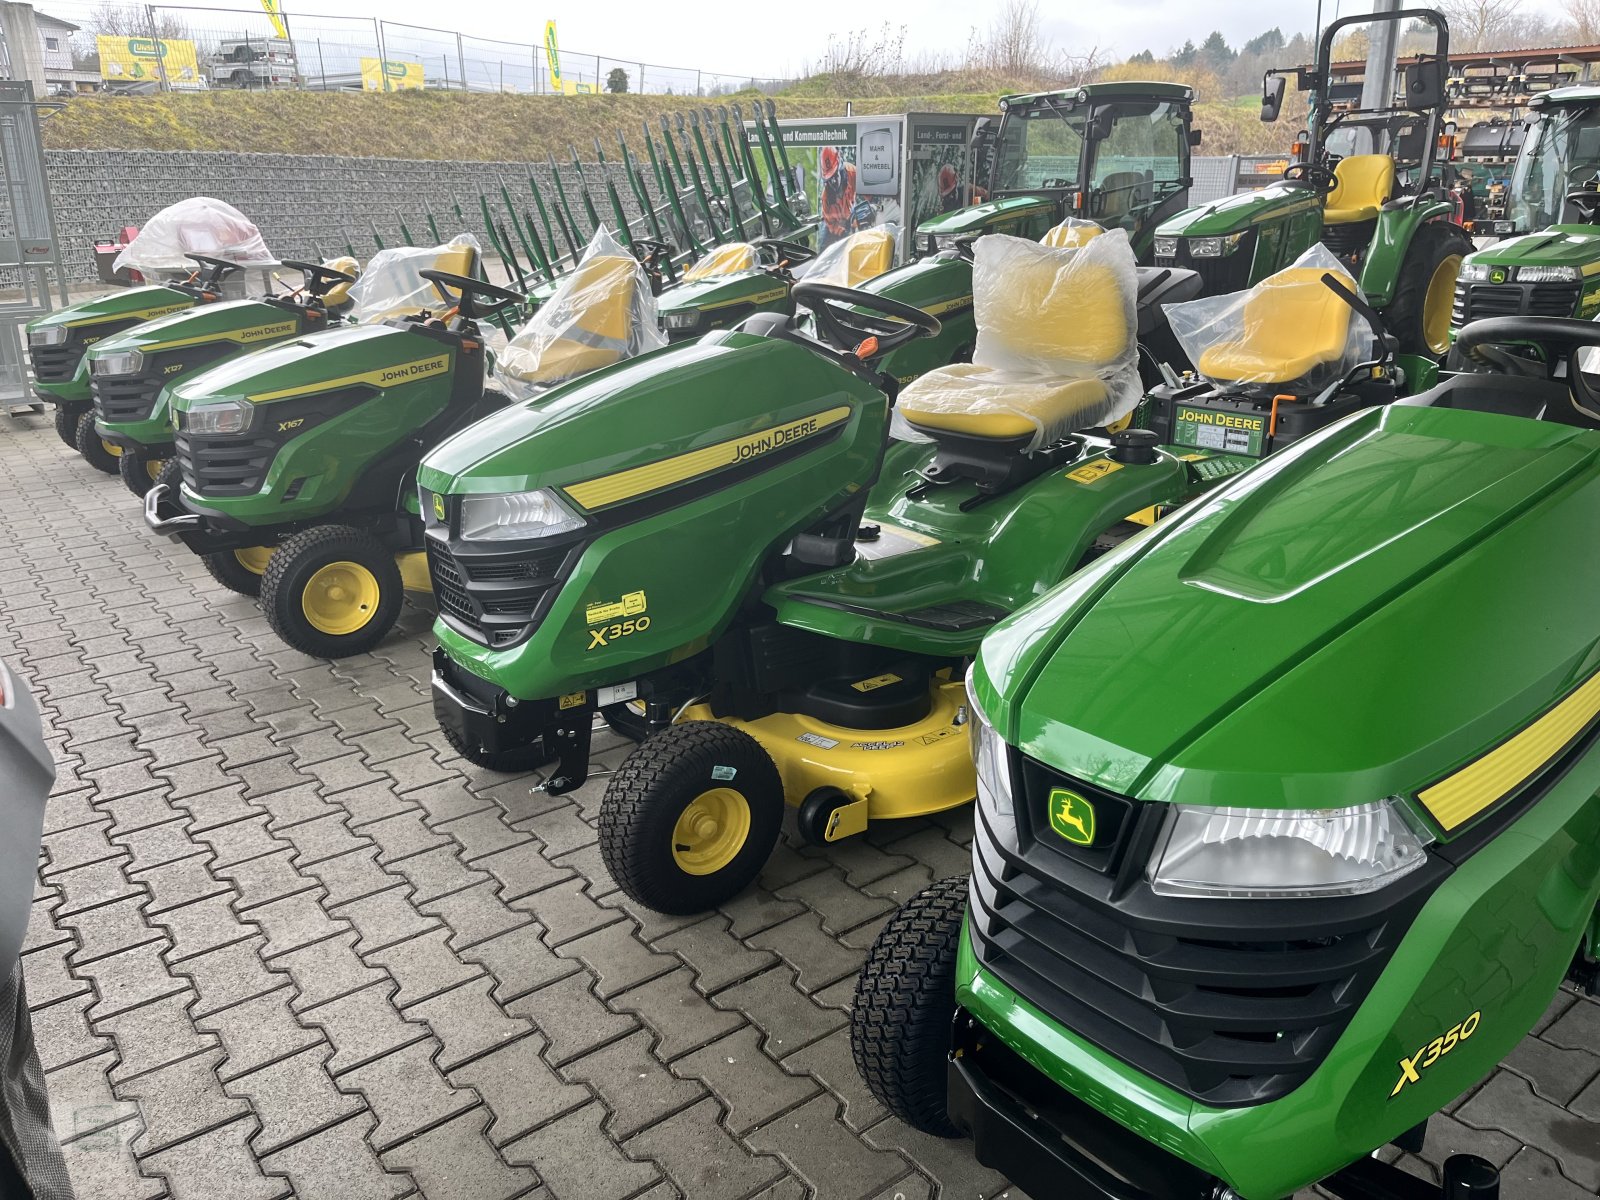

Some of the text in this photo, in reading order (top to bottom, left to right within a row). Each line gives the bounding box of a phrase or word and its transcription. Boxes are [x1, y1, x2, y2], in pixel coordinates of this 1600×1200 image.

[783, 130, 794, 141] und
[795, 129, 848, 141] Kommunaltechnik
[147, 308, 166, 318] JOHN
[240, 324, 292, 339] JOHN DEERE
[163, 364, 183, 374] X127
[380, 360, 444, 382] JOHN DEERE
[278, 418, 304, 432] X167
[1178, 409, 1262, 431] JOHN DEERE
[732, 419, 818, 463] JOHN DEERE
[586, 616, 651, 651] X350
[1387, 1009, 1482, 1099] X350
